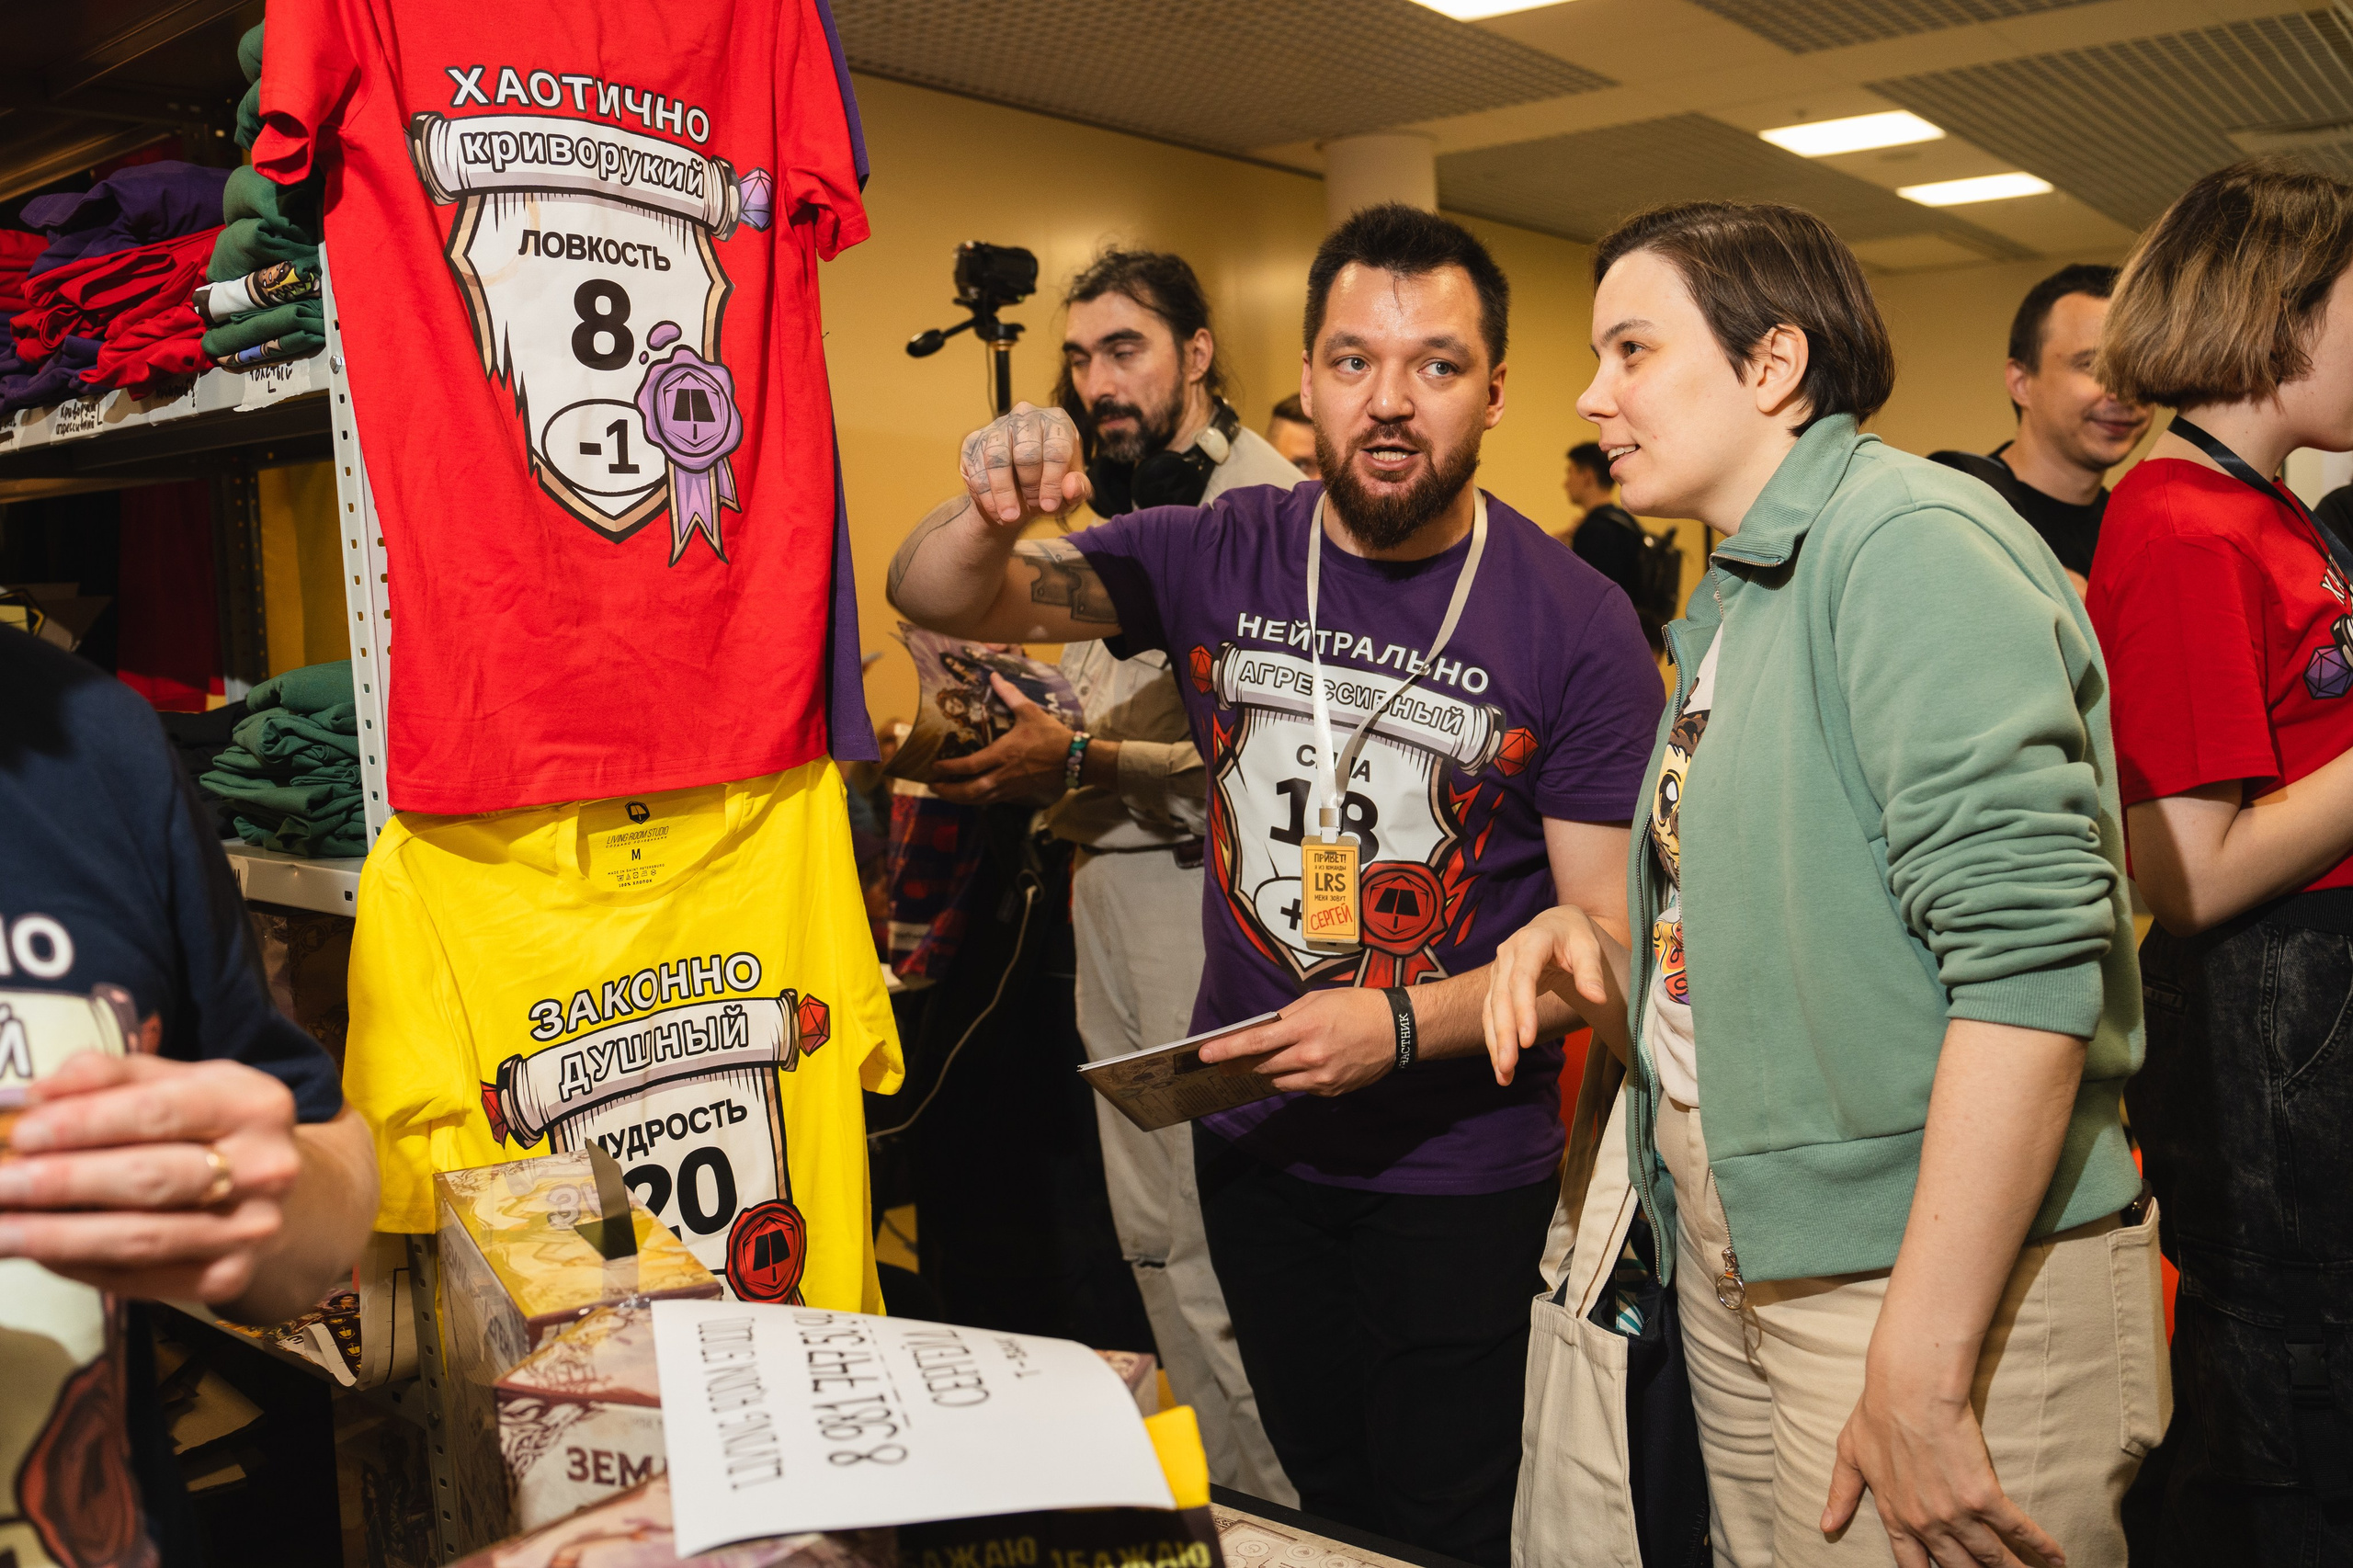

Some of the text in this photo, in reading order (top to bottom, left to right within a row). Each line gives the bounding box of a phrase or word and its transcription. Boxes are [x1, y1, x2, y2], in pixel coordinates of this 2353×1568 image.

[446, 64, 710, 143] ХАОТИЧНО
[460, 129, 706, 199] криворукий
[517, 229, 671, 272] ЛОВКОСТЬ
[570, 278, 634, 370] 8
[579, 418, 640, 474] -1
[1296, 744, 1371, 783] СА
[607, 825, 669, 845] LIVING ROOM STUDIO
[1269, 777, 1380, 865] 18
[631, 848, 641, 860] M
[1314, 853, 1347, 863] ПРИВЕТ!
[1314, 872, 1347, 892] LRS
[1310, 903, 1353, 931] СЕРГЕЙ
[530, 952, 761, 1041] ЗАКОННО
[559, 1006, 748, 1101] ДУШНЫЙ
[1399, 1012, 1411, 1068] ЧАСТНИК
[622, 1146, 738, 1242] 20
[566, 1447, 667, 1488] ЗЕМ
